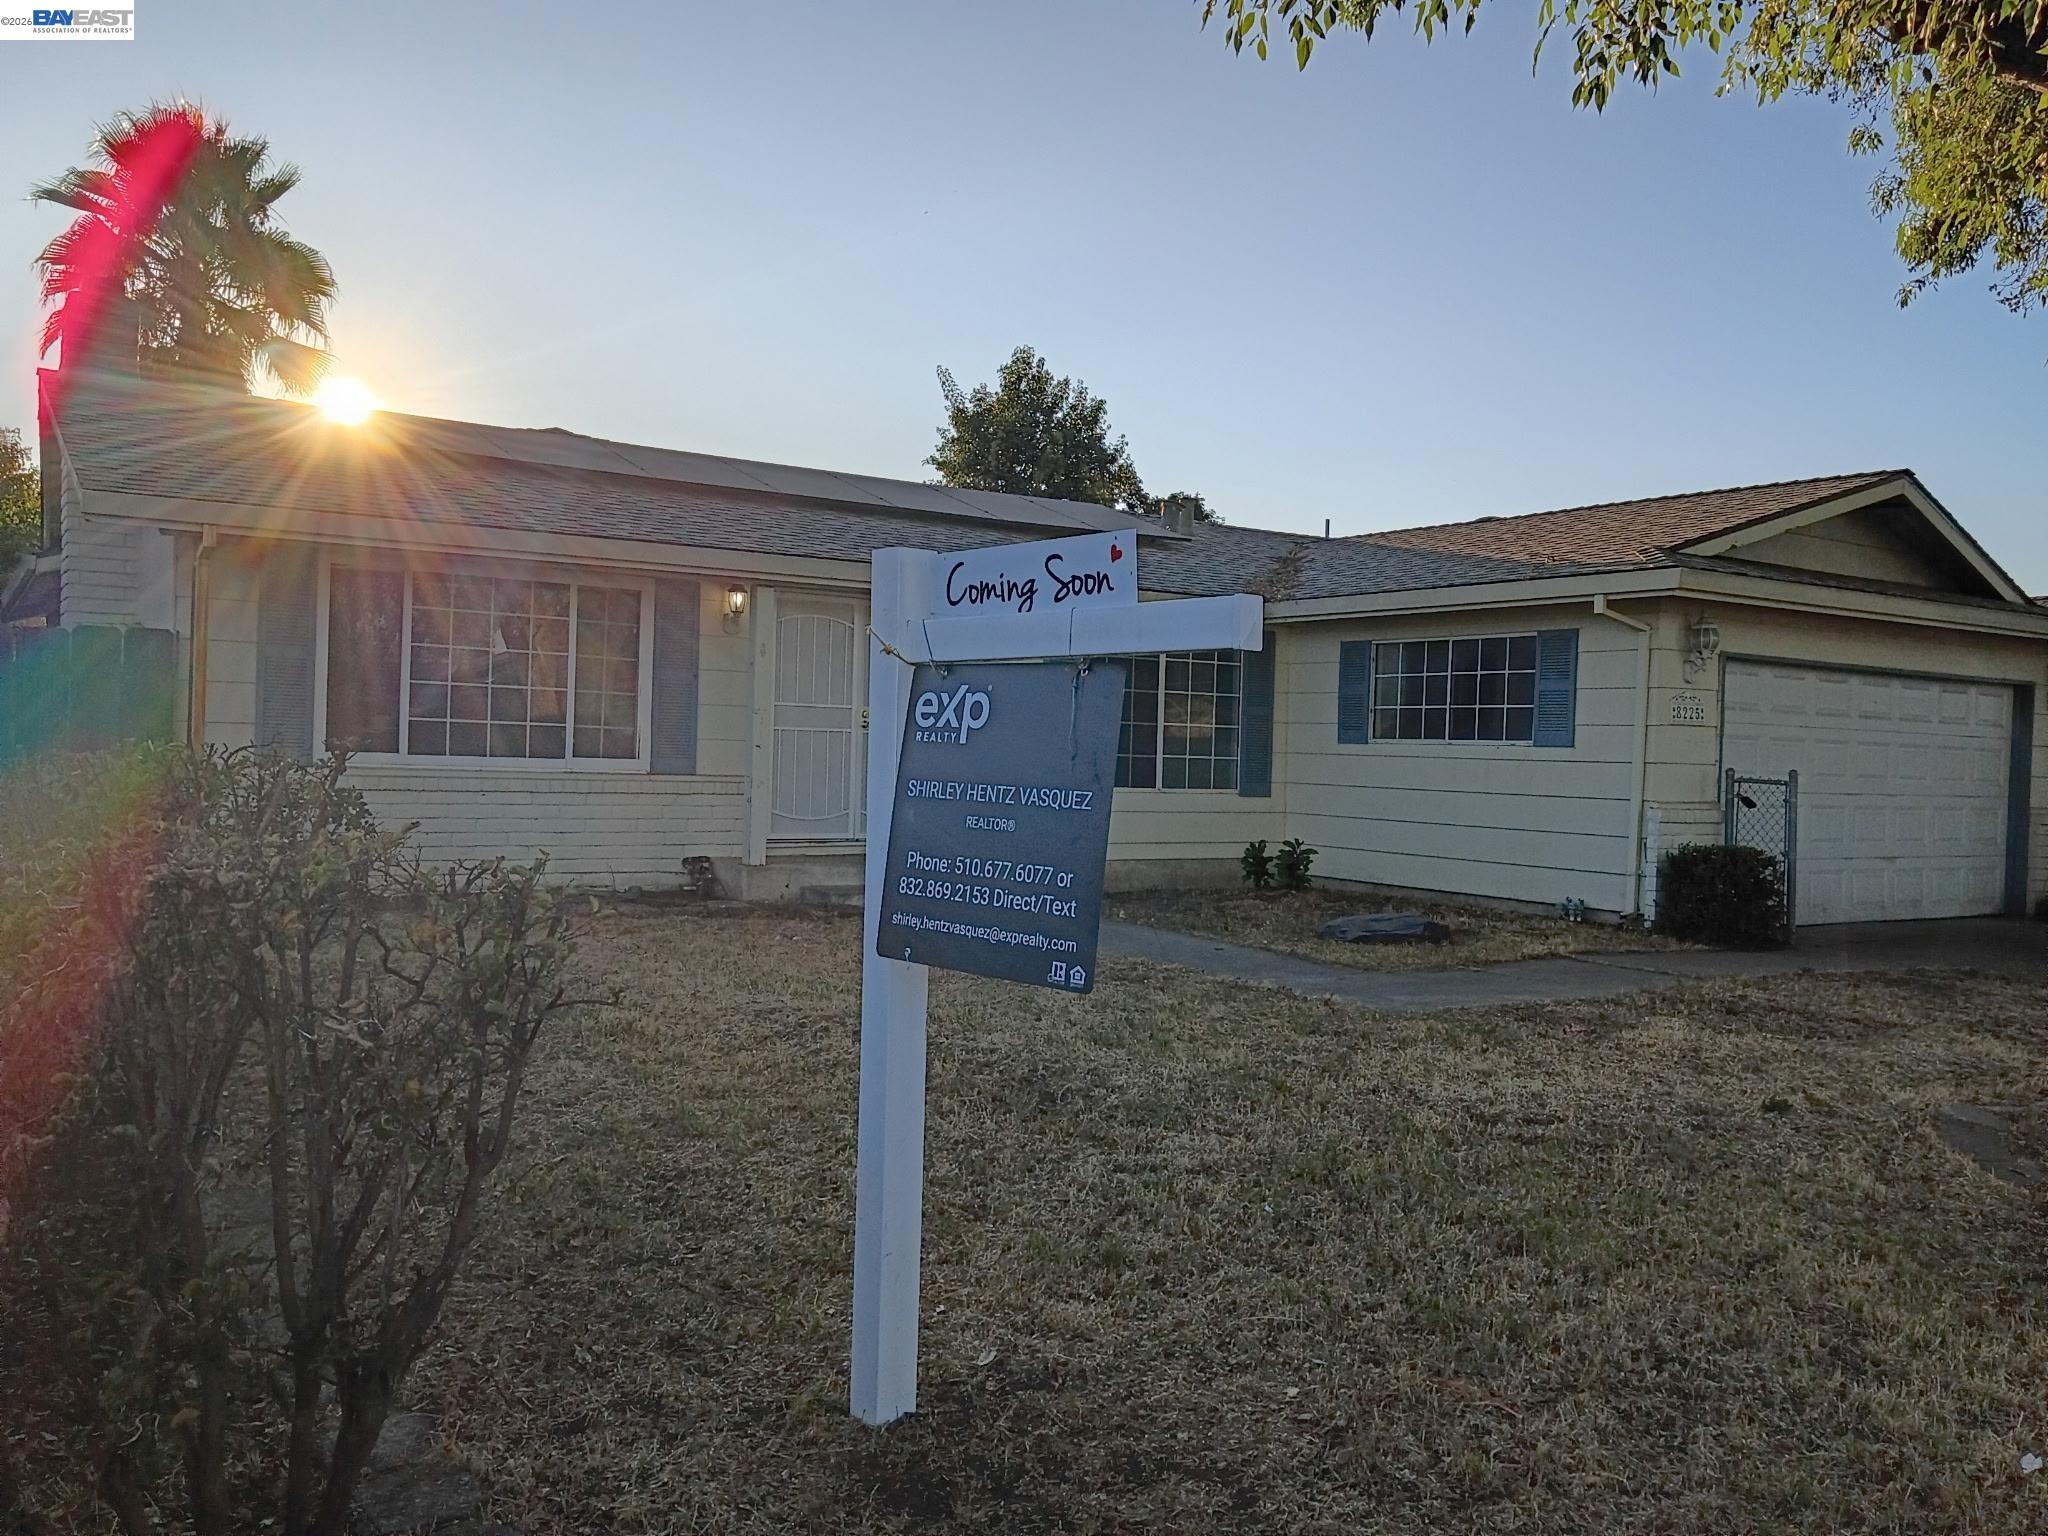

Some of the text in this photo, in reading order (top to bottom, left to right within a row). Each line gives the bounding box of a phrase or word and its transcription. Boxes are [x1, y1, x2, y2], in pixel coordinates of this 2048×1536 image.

[946, 553, 1114, 613] Coming Soon
[916, 731, 957, 743] REALTY
[907, 780, 1093, 811] SHIRLEY HENTZ VASQUEZ
[907, 852, 1074, 888] Phone: 510.677.6077 or
[899, 877, 1077, 918] 832.869.2153 Direct/Text
[891, 912, 1077, 953] shirley.hentzvasquez@exprealty.com
